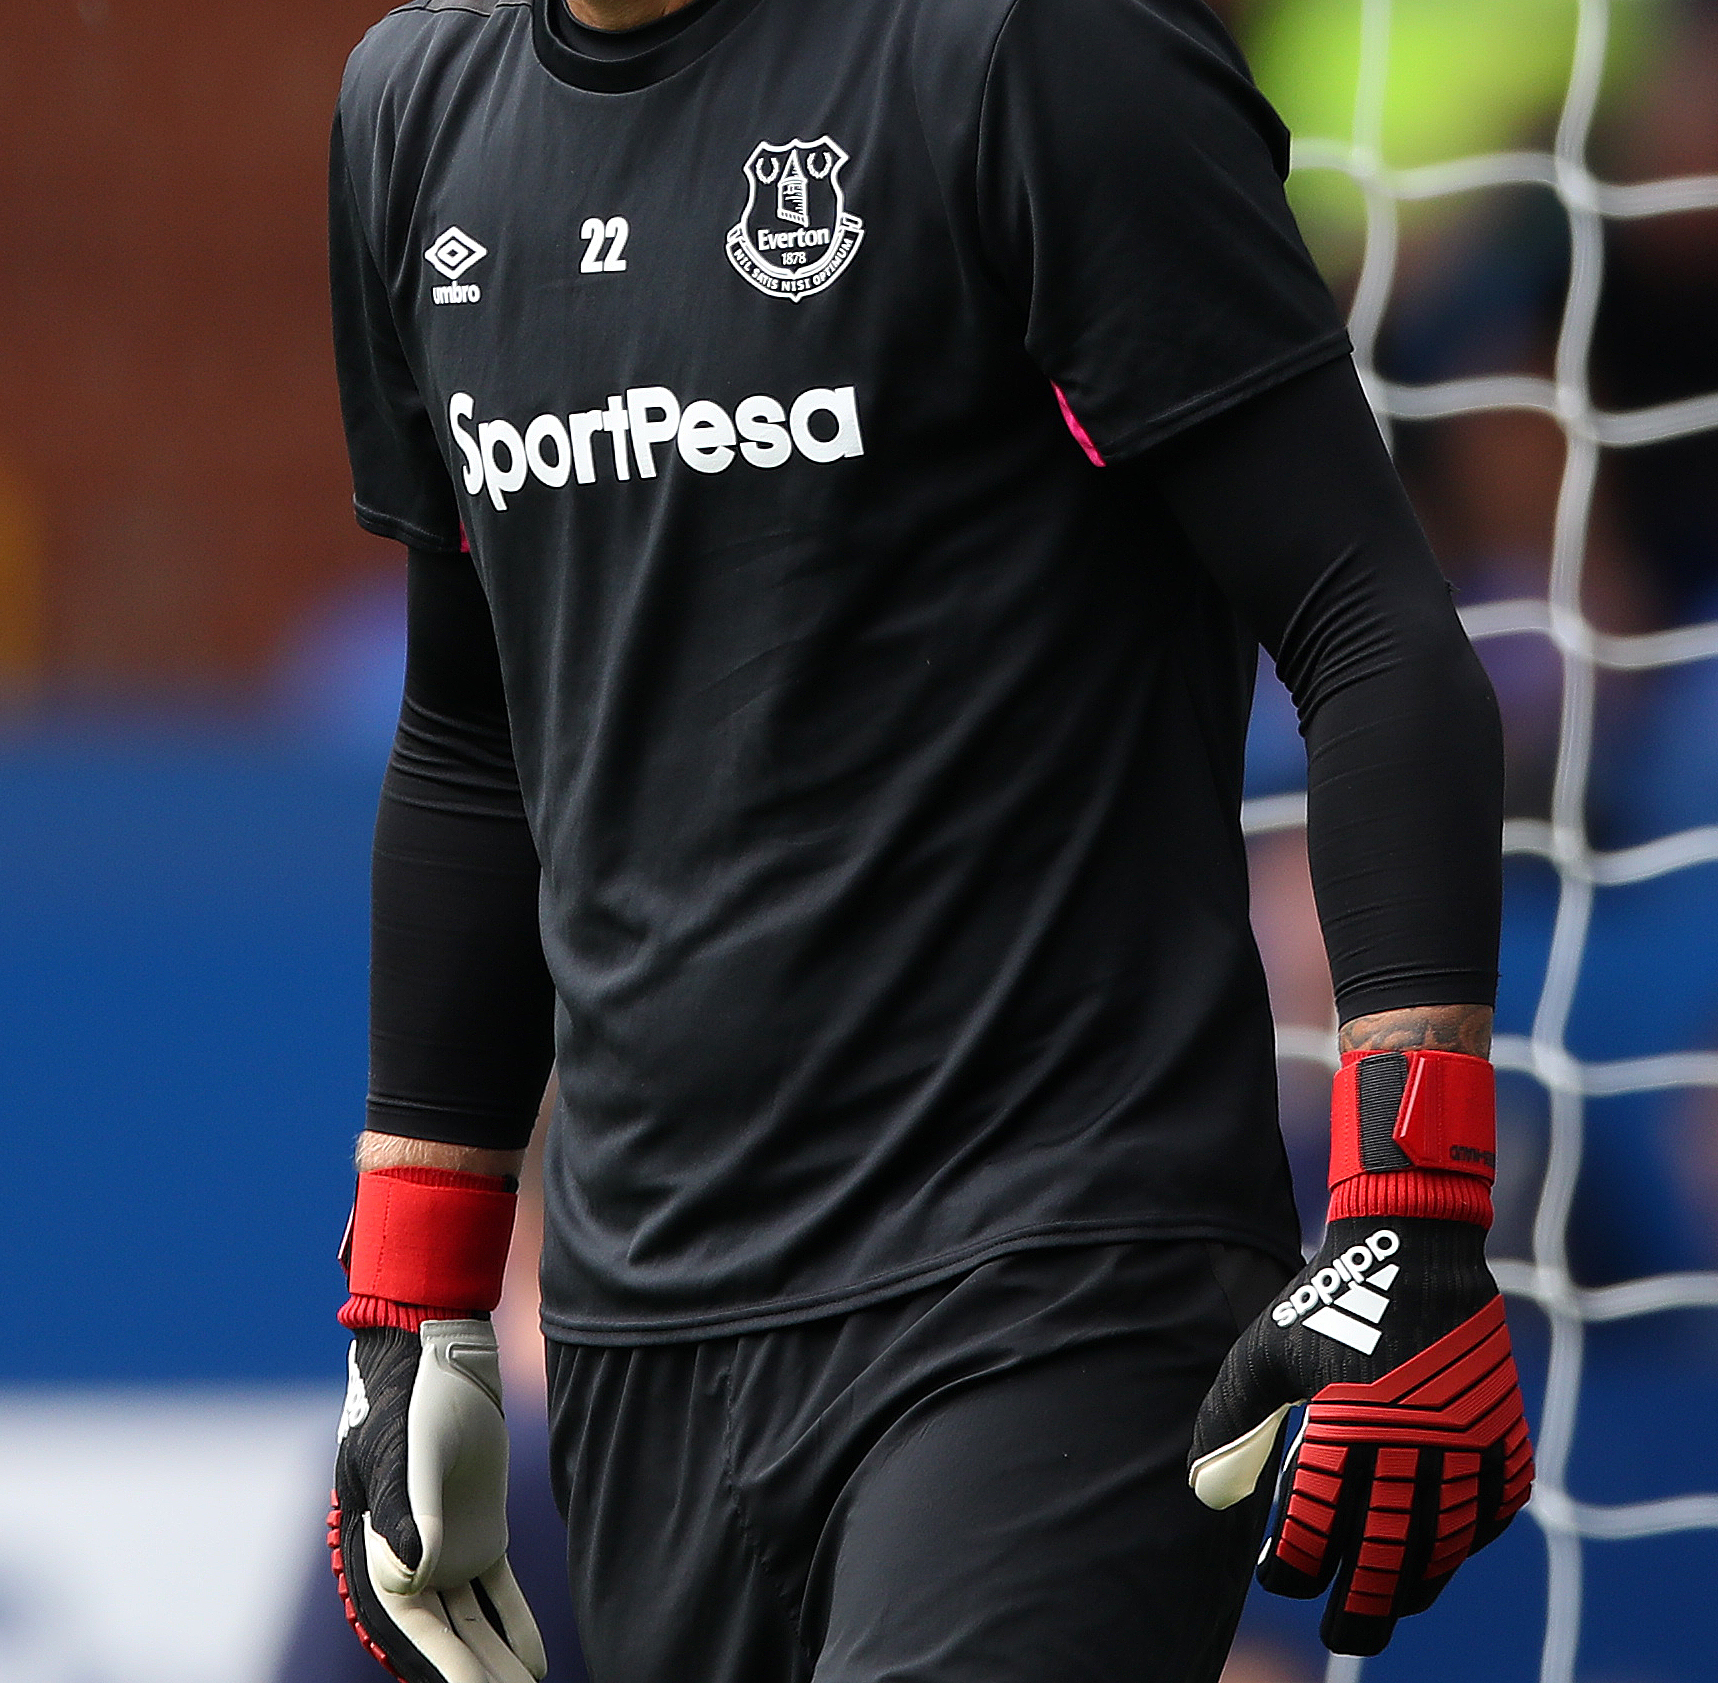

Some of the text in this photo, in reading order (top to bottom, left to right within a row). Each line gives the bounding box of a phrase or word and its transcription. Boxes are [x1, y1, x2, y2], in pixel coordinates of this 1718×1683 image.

[579, 216, 630, 274] 22
[733, 237, 854, 292] NIL SATIS NISI OPTIMUM
[757, 227, 831, 251] Everton
[780, 251, 807, 266] 1878
[432, 280, 481, 305] umbro
[448, 384, 866, 512] SportPesa
[1271, 1229, 1401, 1328] adidas
